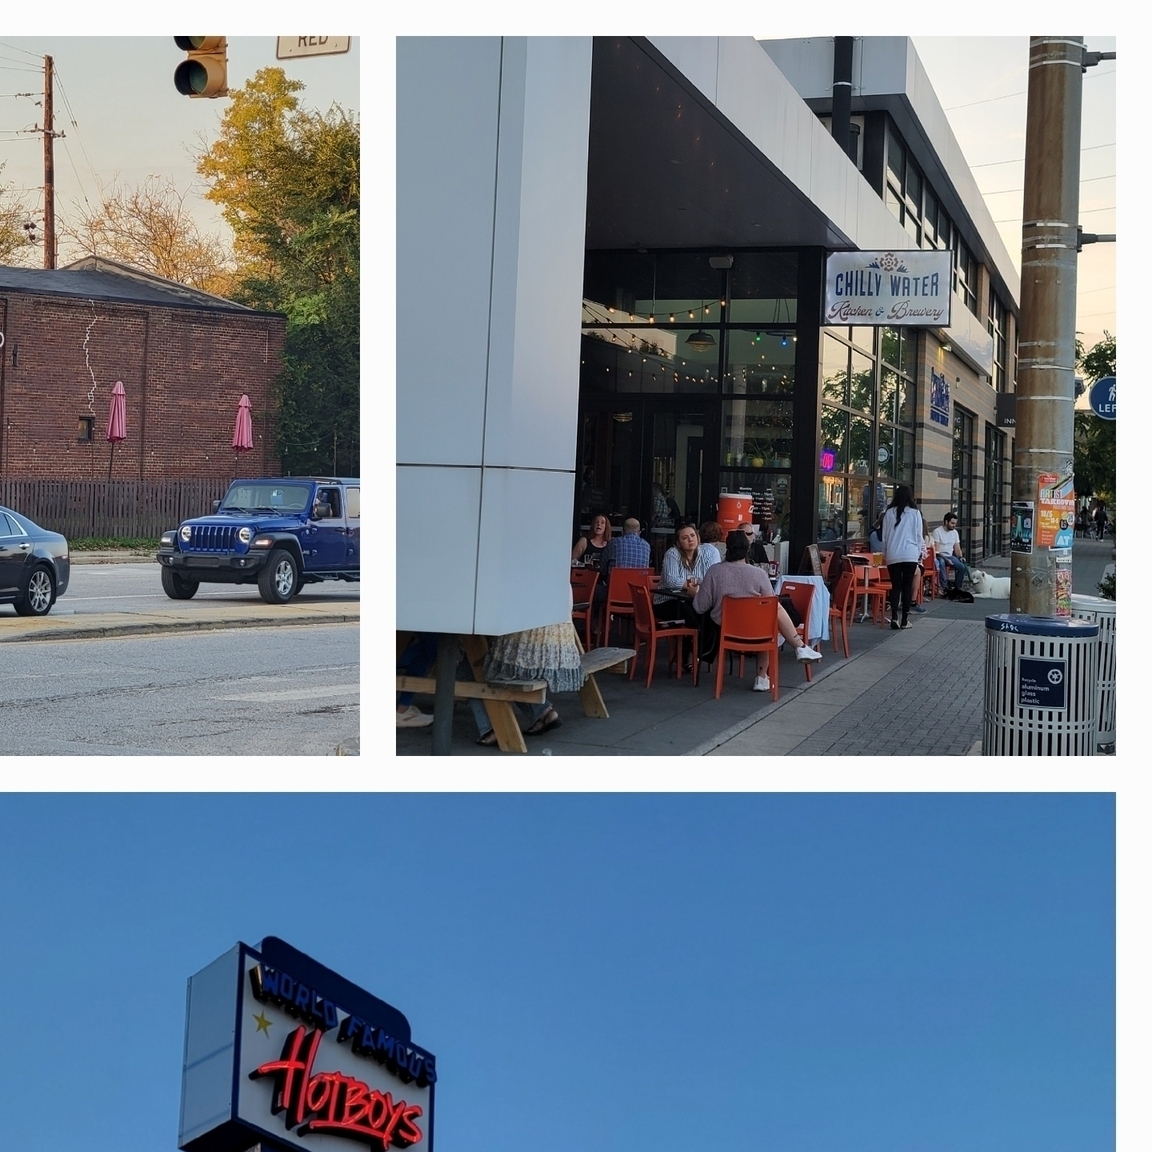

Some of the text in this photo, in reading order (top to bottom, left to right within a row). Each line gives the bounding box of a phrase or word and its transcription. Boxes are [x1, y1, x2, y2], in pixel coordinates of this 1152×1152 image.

[298, 36, 328, 48] RED
[835, 270, 939, 297] CHILLY WATER
[828, 300, 945, 322] Kitchen & Brewery
[1021, 684, 1050, 692] aluminum
[259, 964, 438, 1085] WORLD FAMOUS
